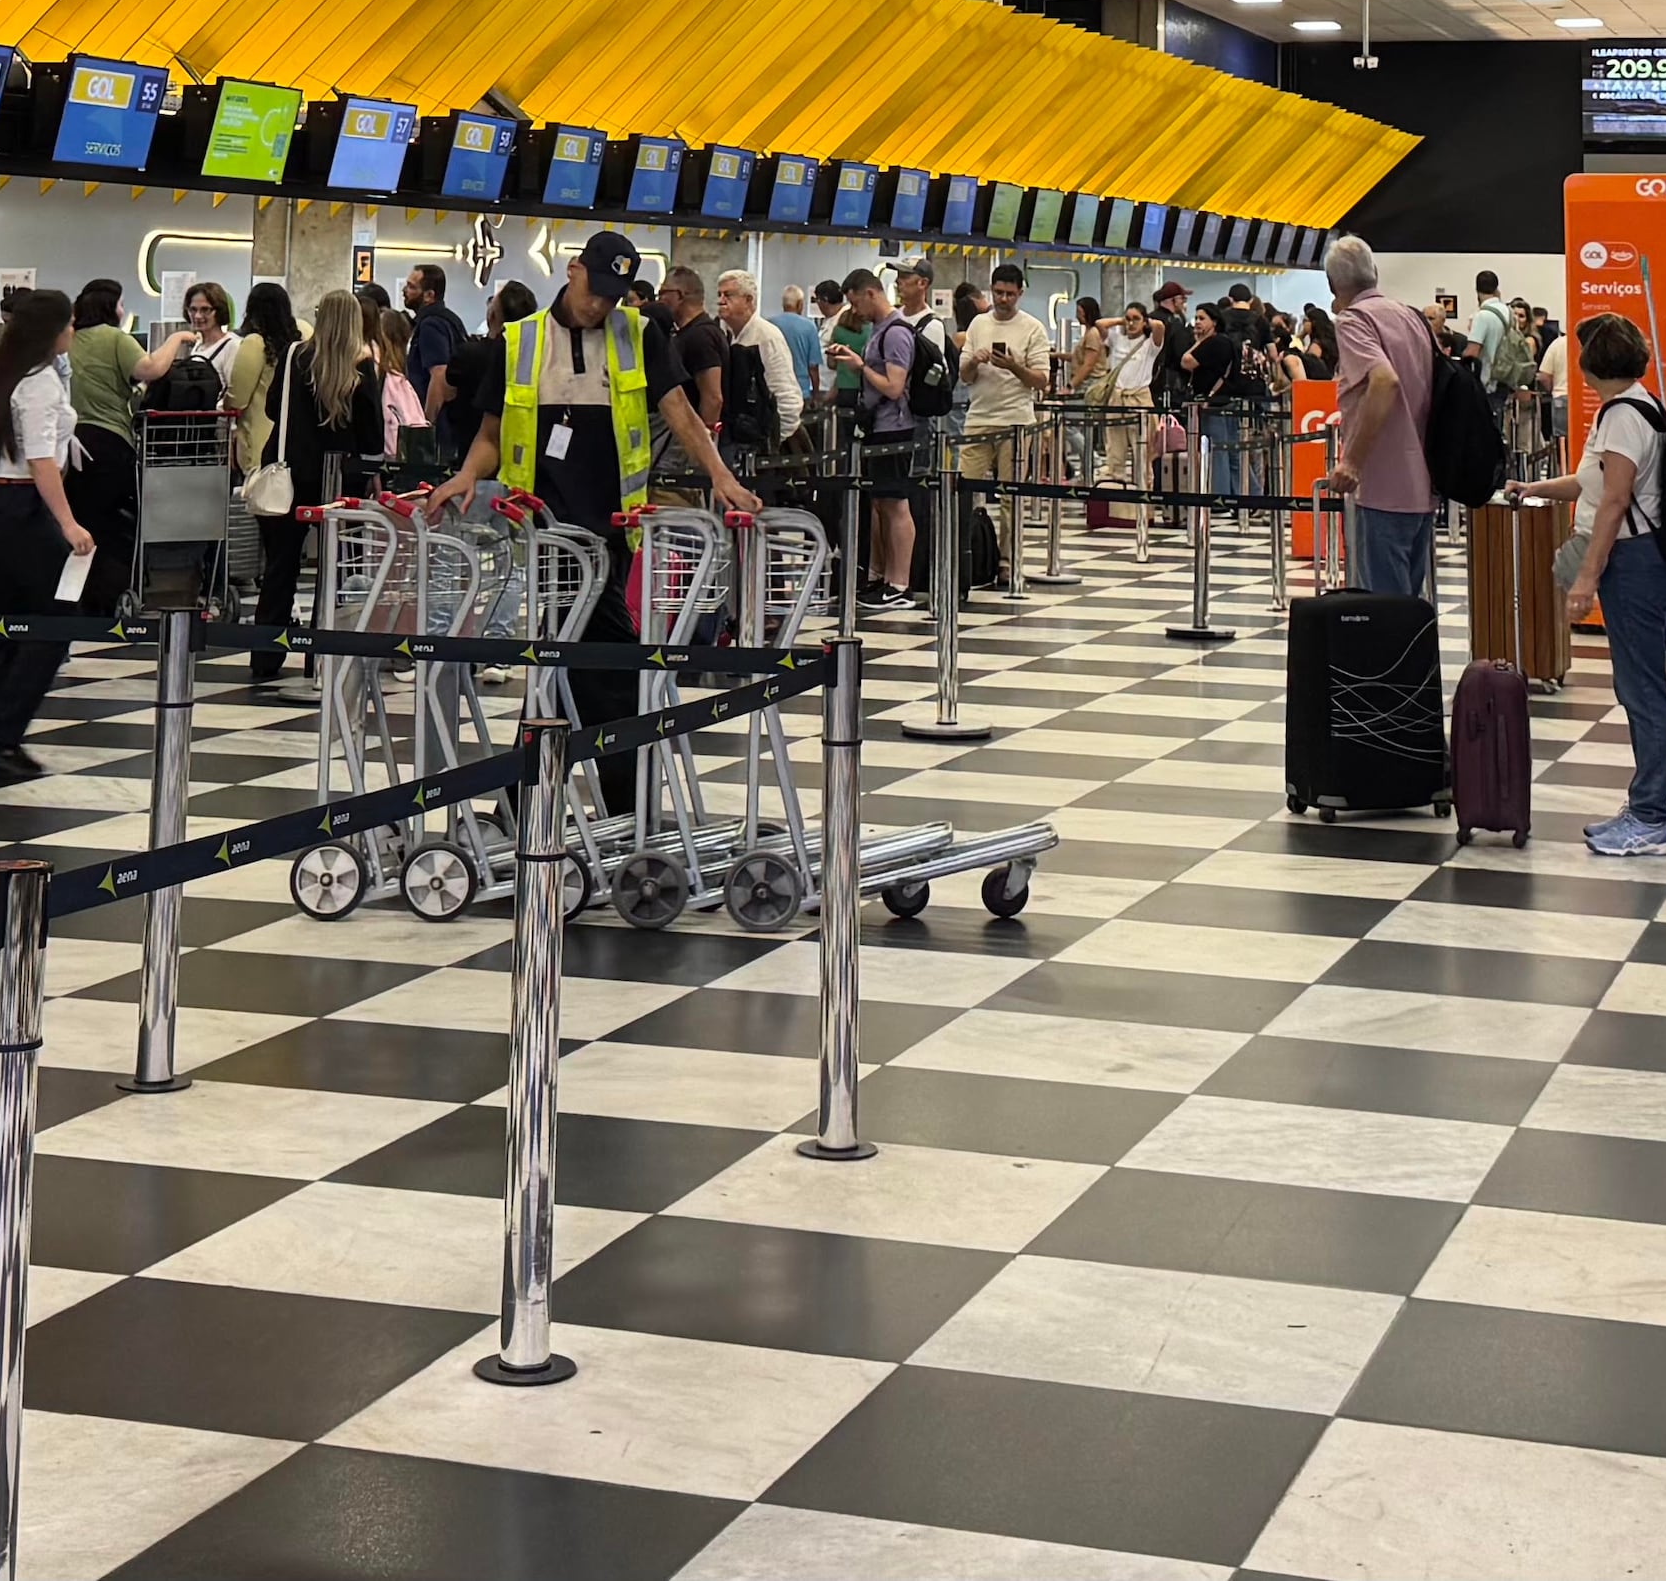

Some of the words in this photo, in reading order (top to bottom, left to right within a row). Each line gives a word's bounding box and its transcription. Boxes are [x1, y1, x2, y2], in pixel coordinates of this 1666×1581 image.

[87, 76, 115, 100] GOL
[142, 82, 159, 102] 55
[356, 113, 376, 134] GOL
[395, 117, 409, 134] 57
[1581, 281, 1642, 298] Serviços
